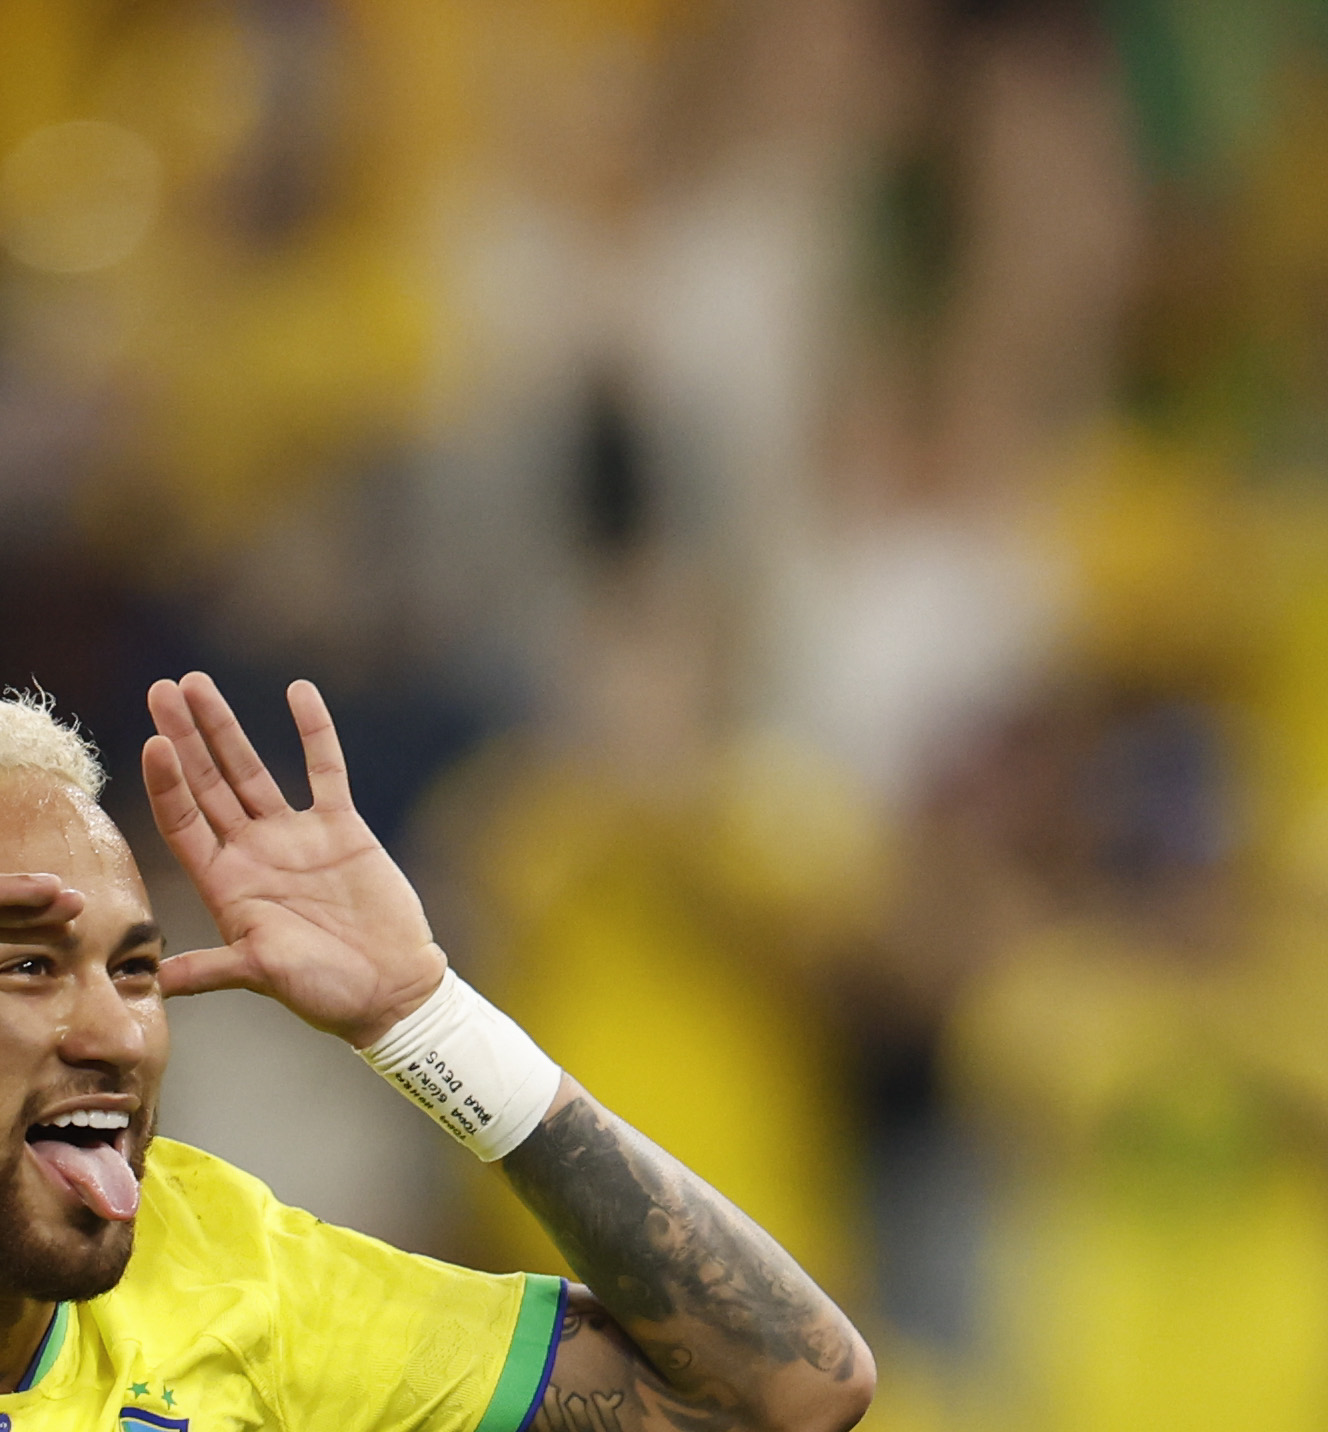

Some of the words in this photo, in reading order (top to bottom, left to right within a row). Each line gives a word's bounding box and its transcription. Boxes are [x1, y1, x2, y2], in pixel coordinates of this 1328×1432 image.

[425, 1051, 463, 1093] DEUS
[451, 1107, 478, 1136] TODA
[464, 1094, 492, 1126] PARA
